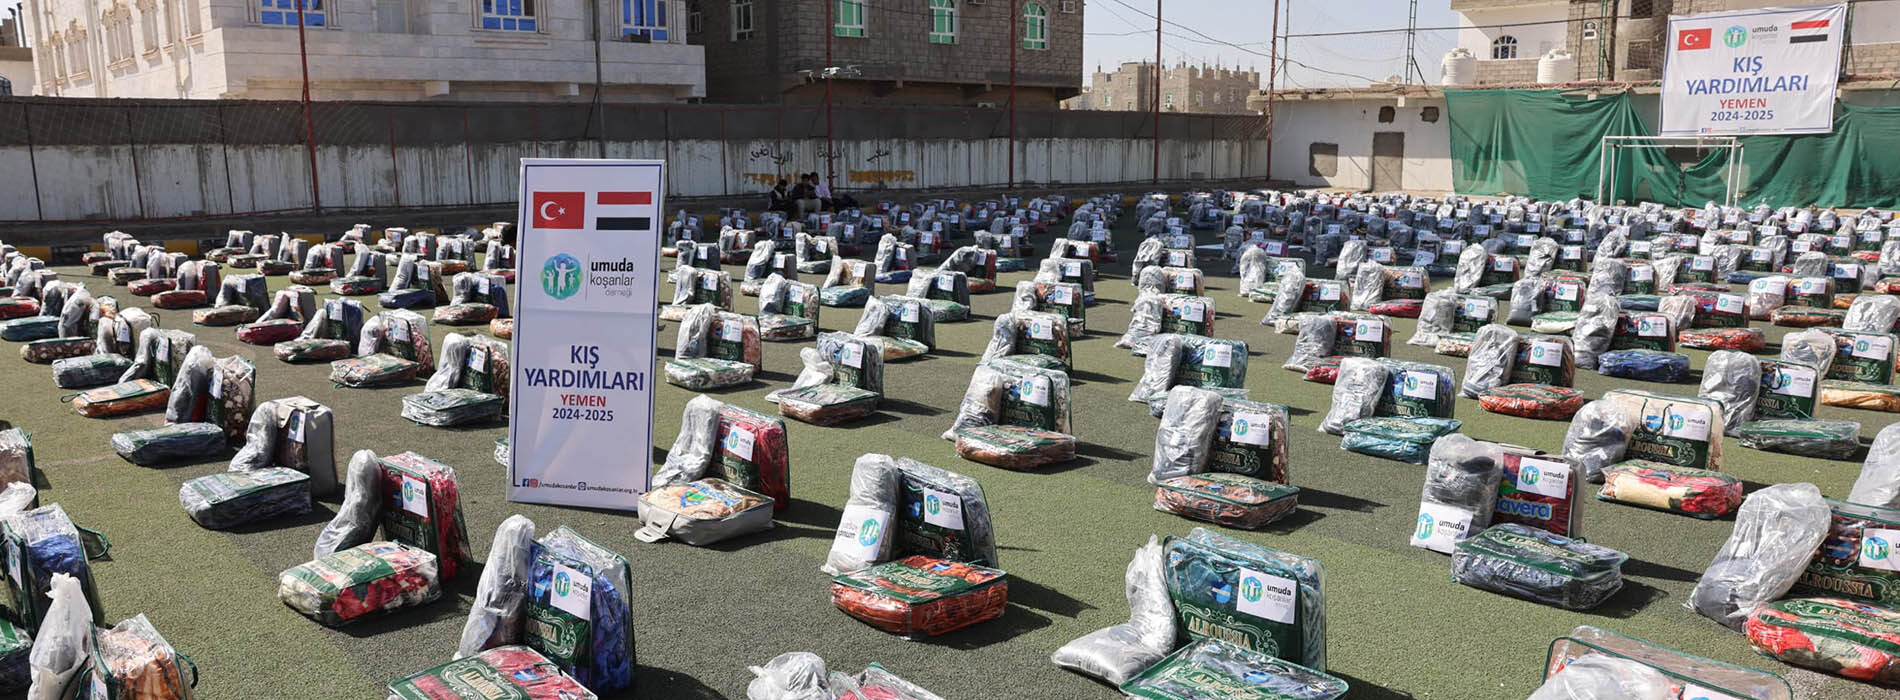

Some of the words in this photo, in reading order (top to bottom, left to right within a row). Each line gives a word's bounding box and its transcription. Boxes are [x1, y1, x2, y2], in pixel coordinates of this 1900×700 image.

[1752, 24, 1778, 33] umuda
[1733, 55, 1763, 76] KIŞ
[1686, 75, 1809, 96] YARDIMLARI
[1720, 98, 1767, 109] YEMEN
[1711, 110, 1774, 122] 2024-2025
[591, 258, 633, 272] umuda
[590, 274, 634, 288] koşanlar
[571, 345, 600, 369] KIŞ
[524, 368, 645, 391] YARDIMLARI
[560, 394, 607, 407] YEMEN
[552, 408, 614, 422] 2024-2025
[1495, 499, 1552, 518] avera
[1439, 520, 1465, 531] umuda
[1266, 584, 1292, 596] umuda
